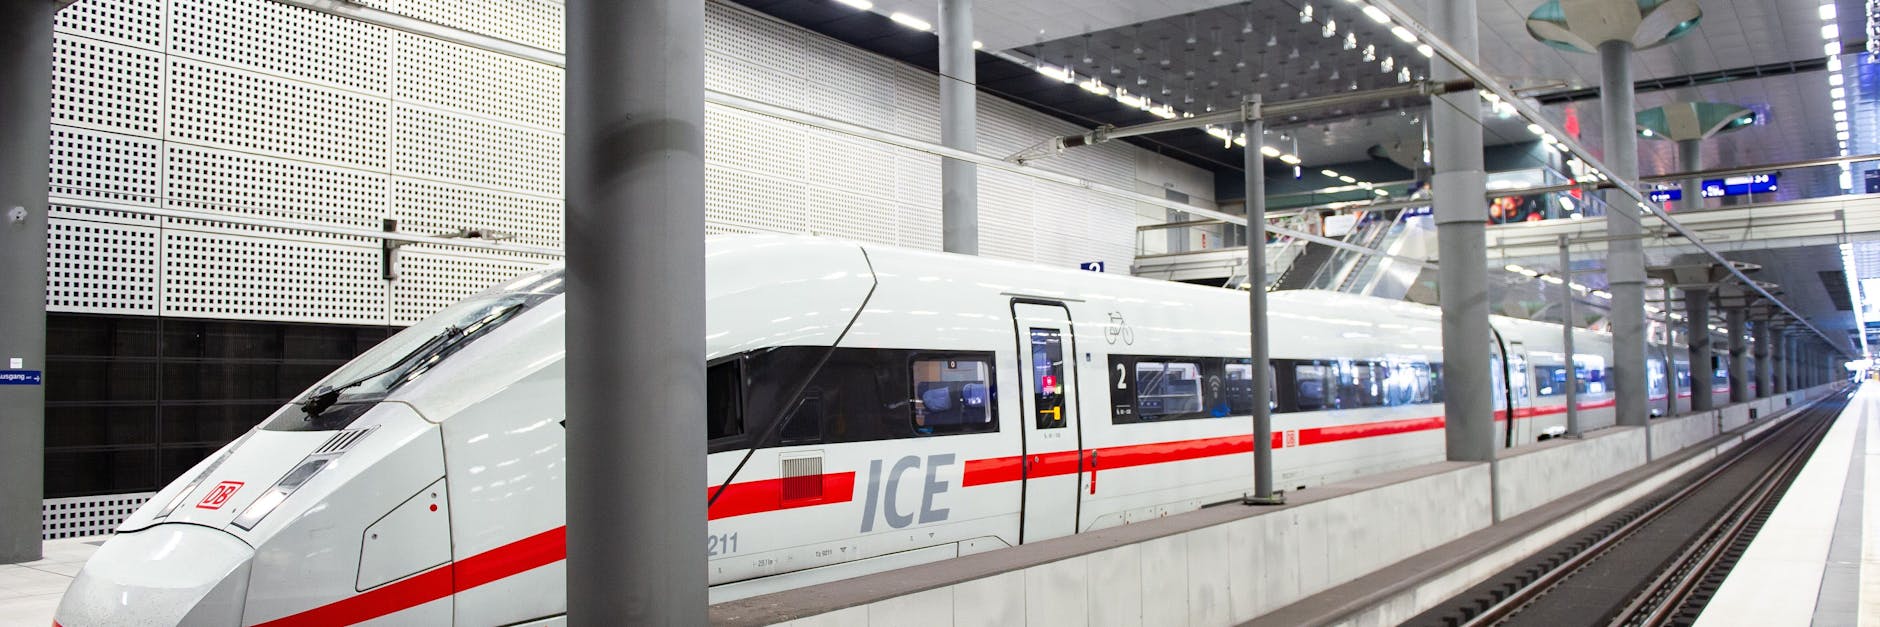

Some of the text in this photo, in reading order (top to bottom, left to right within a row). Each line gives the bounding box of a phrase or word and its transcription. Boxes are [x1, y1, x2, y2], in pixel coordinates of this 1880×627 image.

[1117, 363, 1127, 389] 2
[202, 484, 237, 505] DB
[860, 453, 956, 533] ICE
